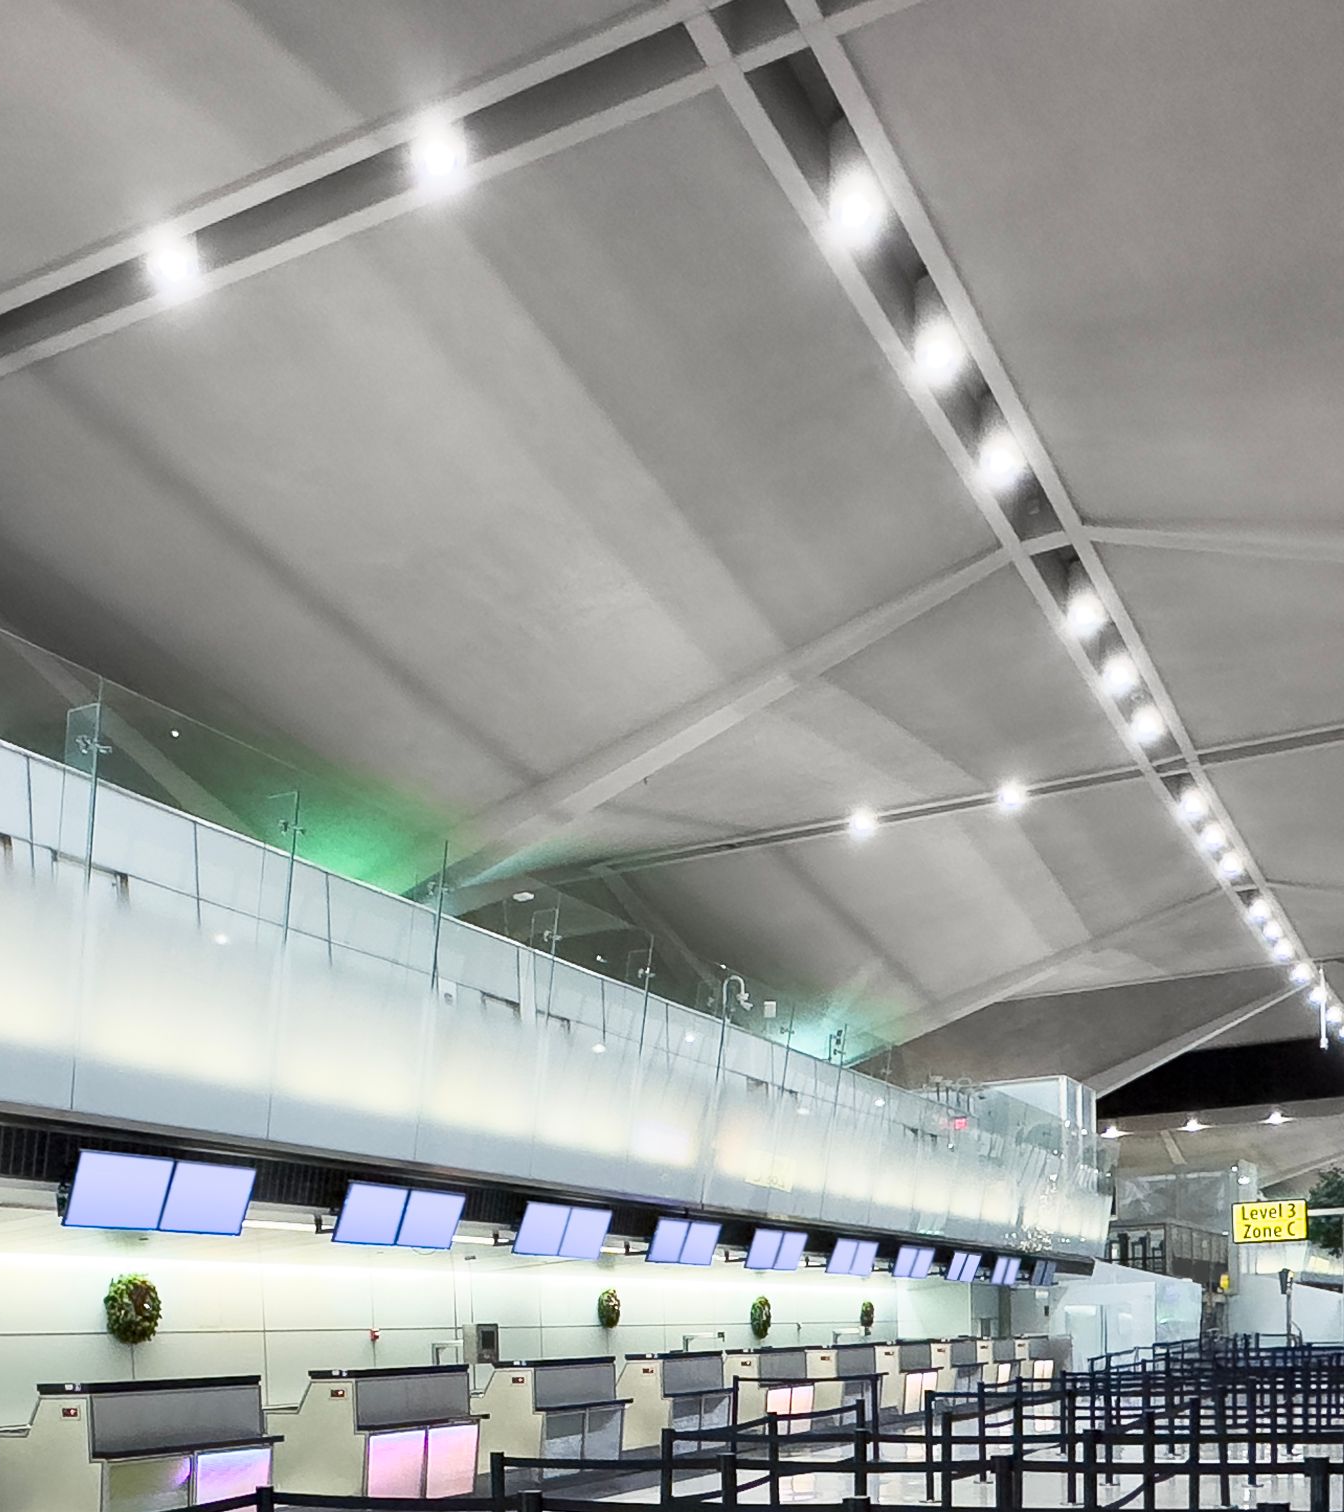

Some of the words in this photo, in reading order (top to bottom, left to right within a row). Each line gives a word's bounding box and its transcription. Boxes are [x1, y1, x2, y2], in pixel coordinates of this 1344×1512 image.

[1241, 1203, 1282, 1221] Level
[1288, 1203, 1296, 1219] 3
[1243, 1224, 1282, 1239] Zone
[1287, 1221, 1296, 1236] C
